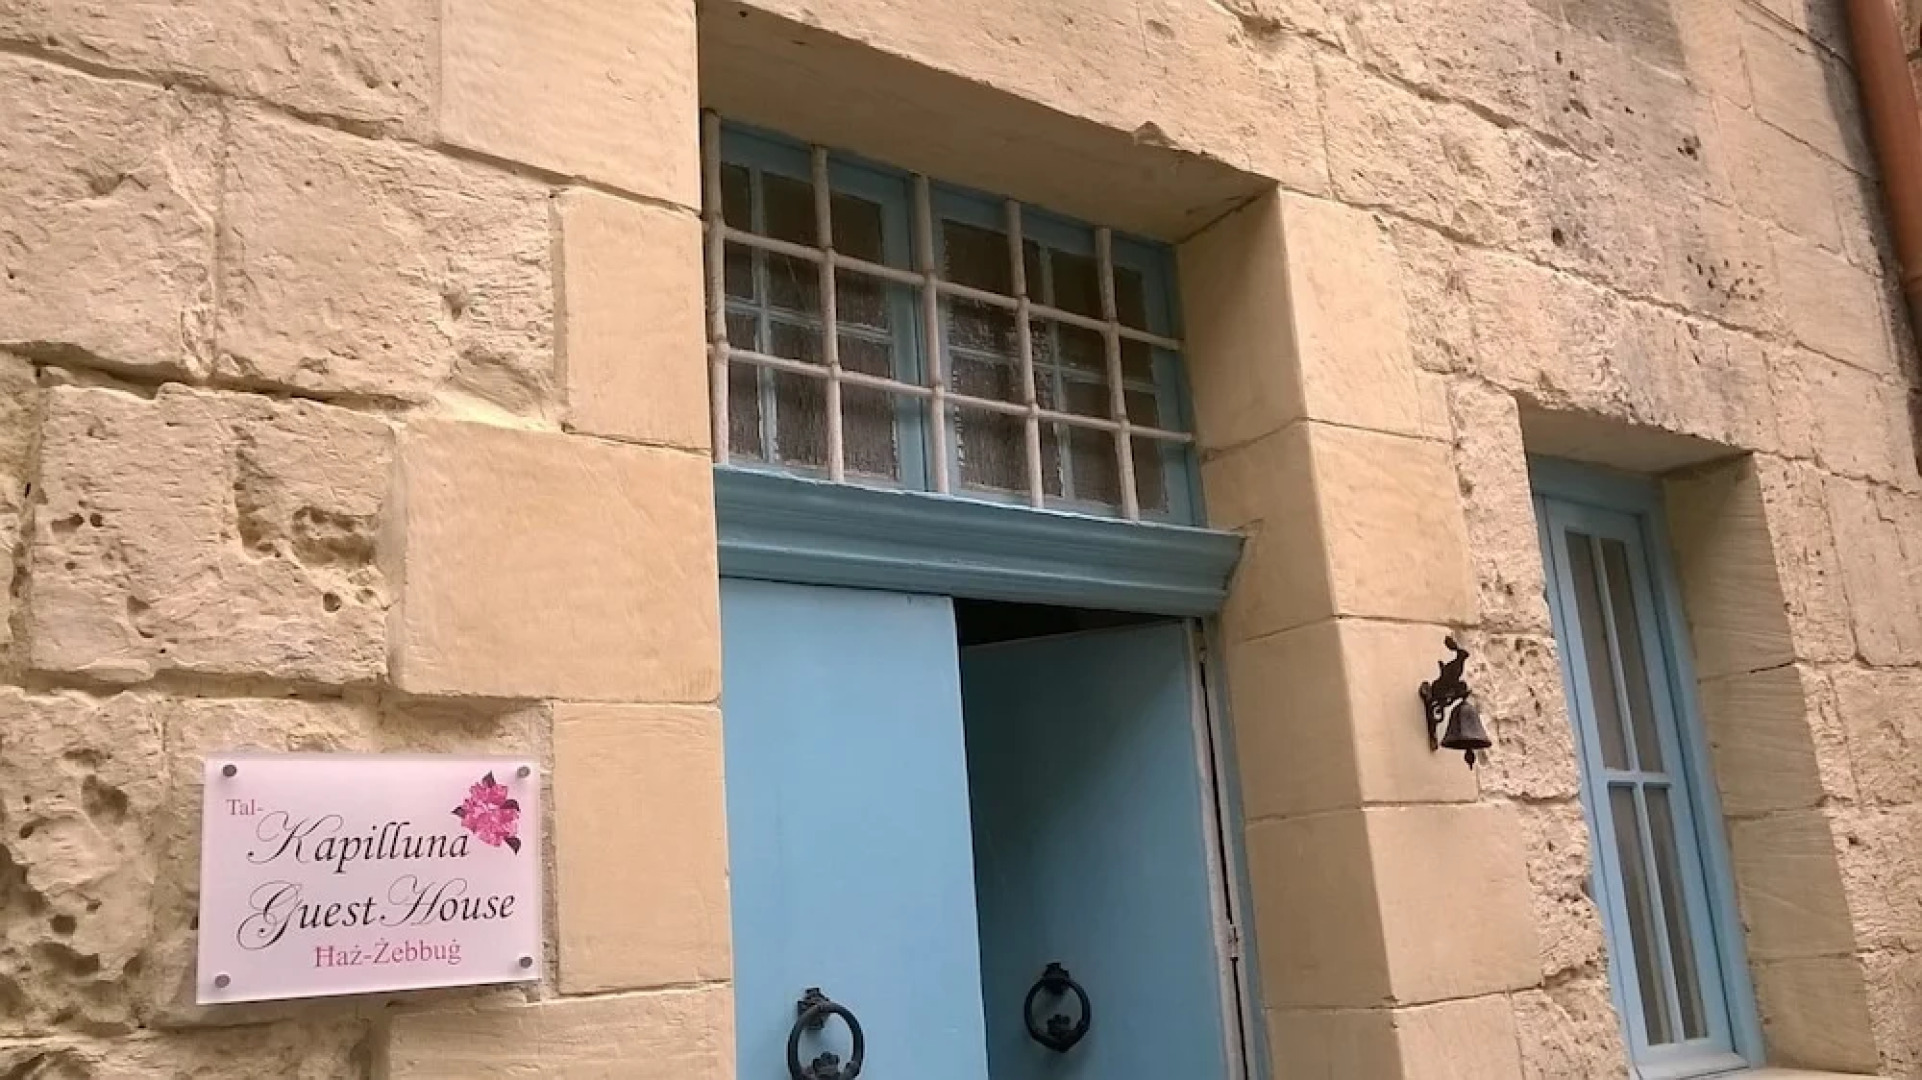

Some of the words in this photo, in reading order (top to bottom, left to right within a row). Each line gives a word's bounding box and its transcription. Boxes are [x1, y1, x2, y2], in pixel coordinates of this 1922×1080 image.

[226, 799, 264, 816] Tal-
[247, 810, 470, 875] Kapilluna
[236, 879, 377, 951] Guest
[379, 874, 516, 928] House
